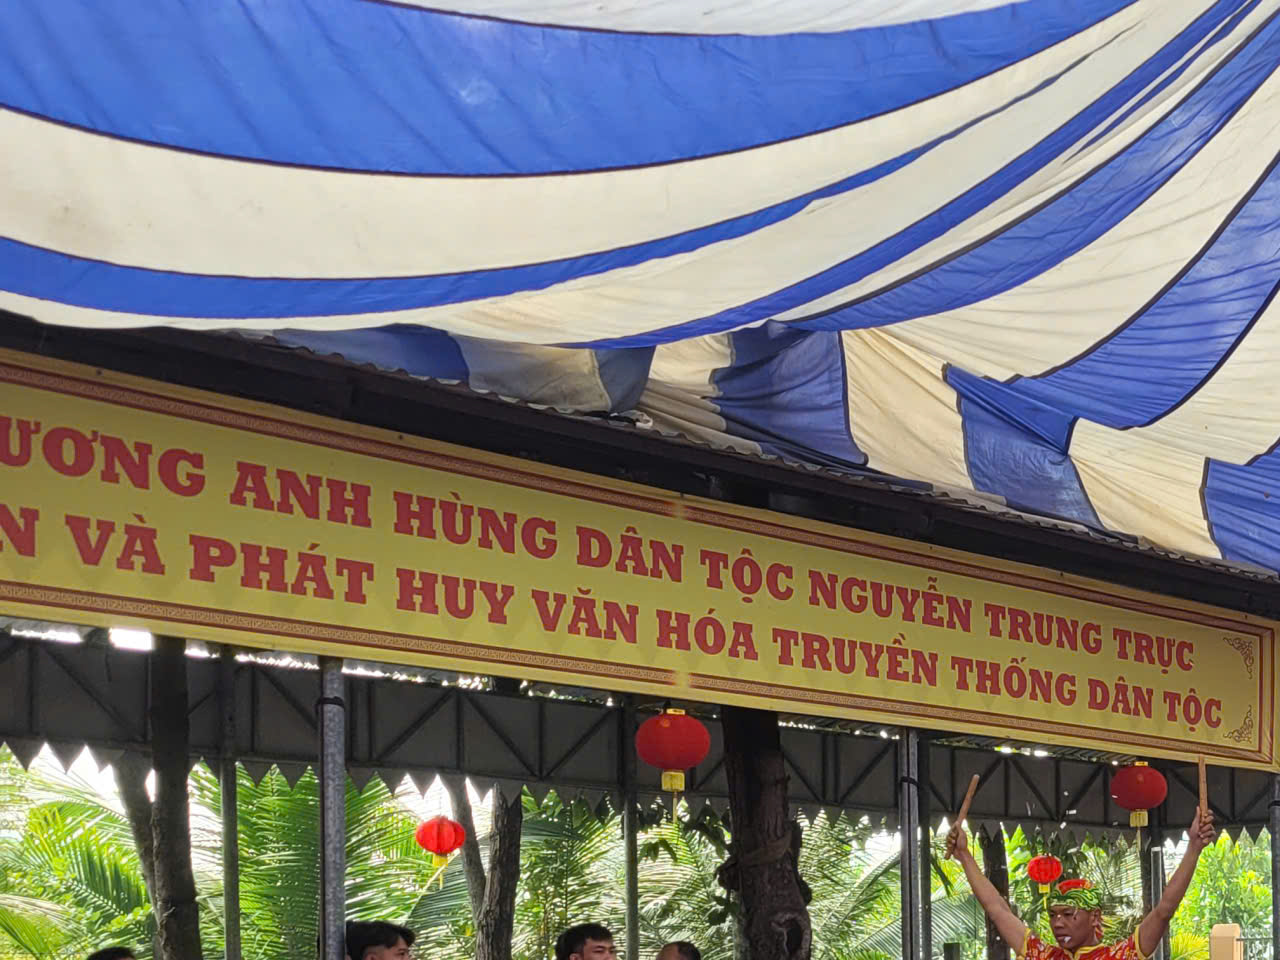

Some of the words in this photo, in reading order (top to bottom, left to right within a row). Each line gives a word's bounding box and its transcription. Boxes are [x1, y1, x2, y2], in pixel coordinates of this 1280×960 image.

[65, 513, 165, 575] VÀ
[189, 534, 374, 604] PHÁT
[396, 567, 515, 625] HUY
[531, 586, 639, 644] VĂN
[656, 608, 758, 661] HÓA
[772, 628, 939, 688] TRUYỀN
[951, 655, 1077, 706] THỐNG
[1087, 682, 1153, 720] DÂN
[1163, 690, 1221, 730] TỘC
[231, 462, 372, 528] ANH
[393, 490, 557, 559] HÙNG
[576, 525, 684, 582] DÂN
[700, 547, 794, 603] TỘC
[809, 570, 972, 633] NGUYỄN
[985, 602, 1102, 654] TRUNG
[1112, 628, 1194, 675] TRỰC
